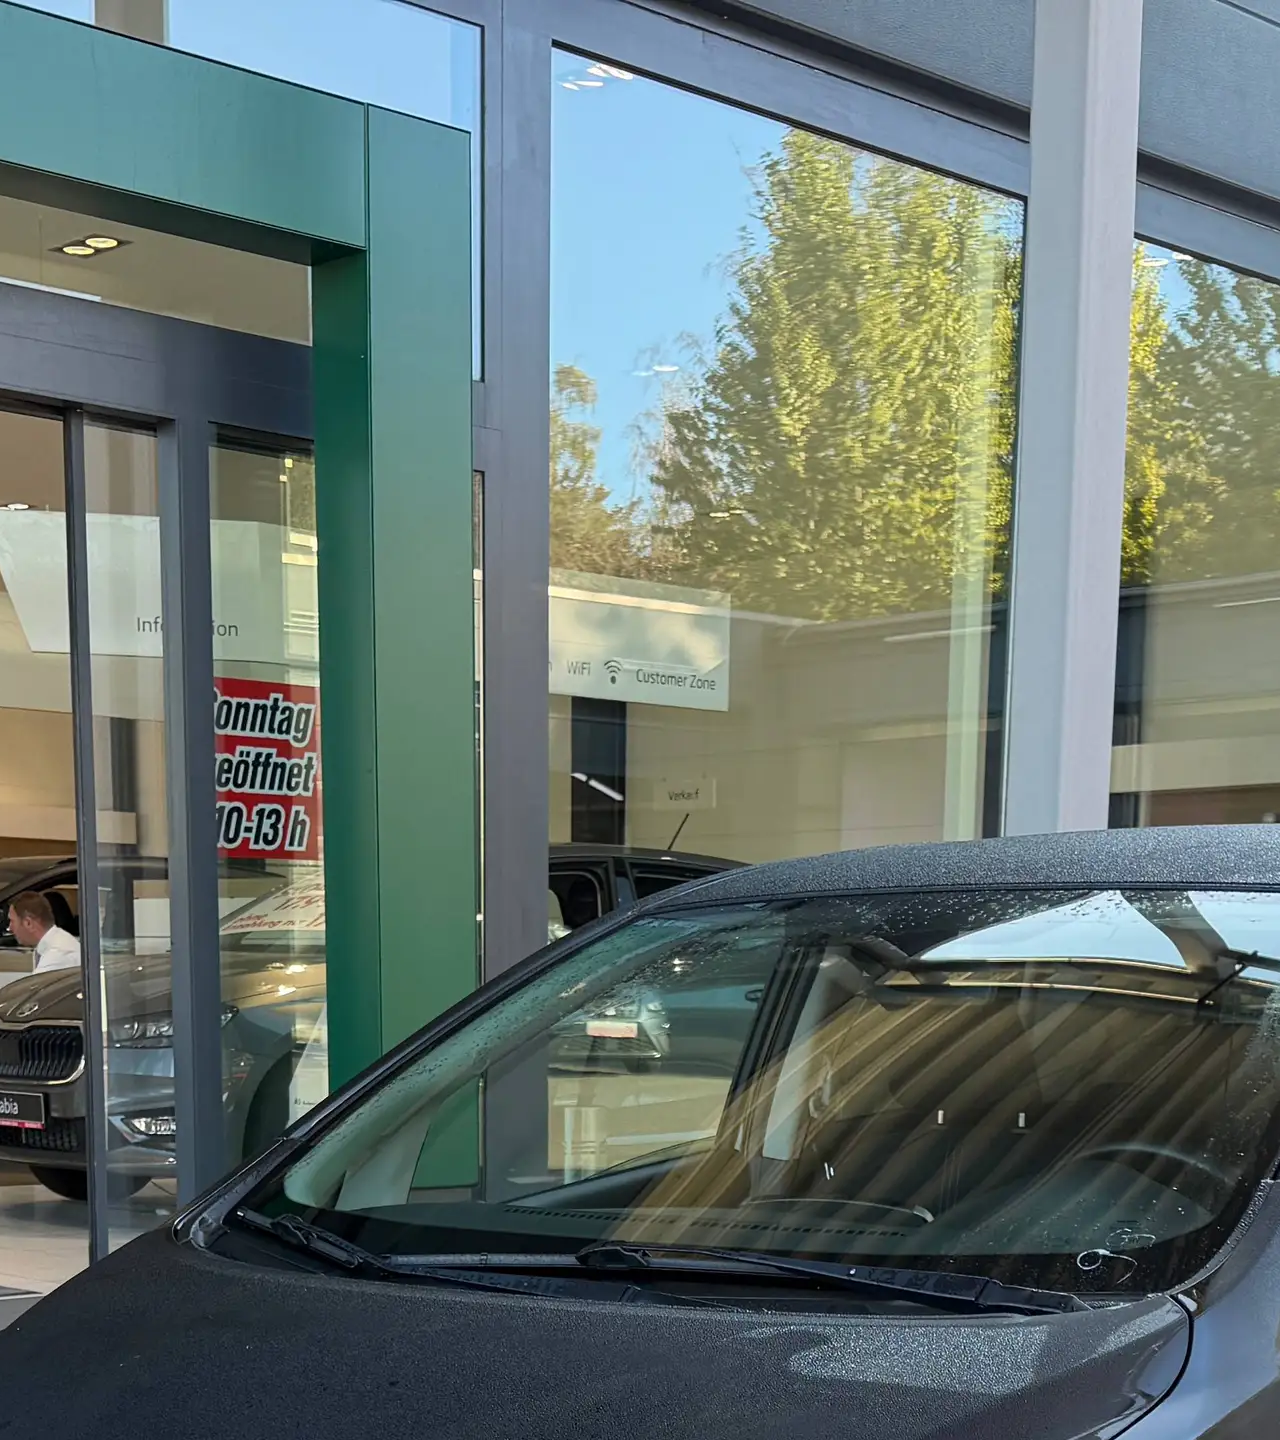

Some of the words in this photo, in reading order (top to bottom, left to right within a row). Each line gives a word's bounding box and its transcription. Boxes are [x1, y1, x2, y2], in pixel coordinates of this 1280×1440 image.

[567, 659, 592, 676] WiFi
[635, 668, 688, 689] Customer
[689, 674, 717, 691] Zone
[214, 694, 315, 746] onntag
[215, 748, 317, 795] eöffnet
[287, 807, 309, 850] h
